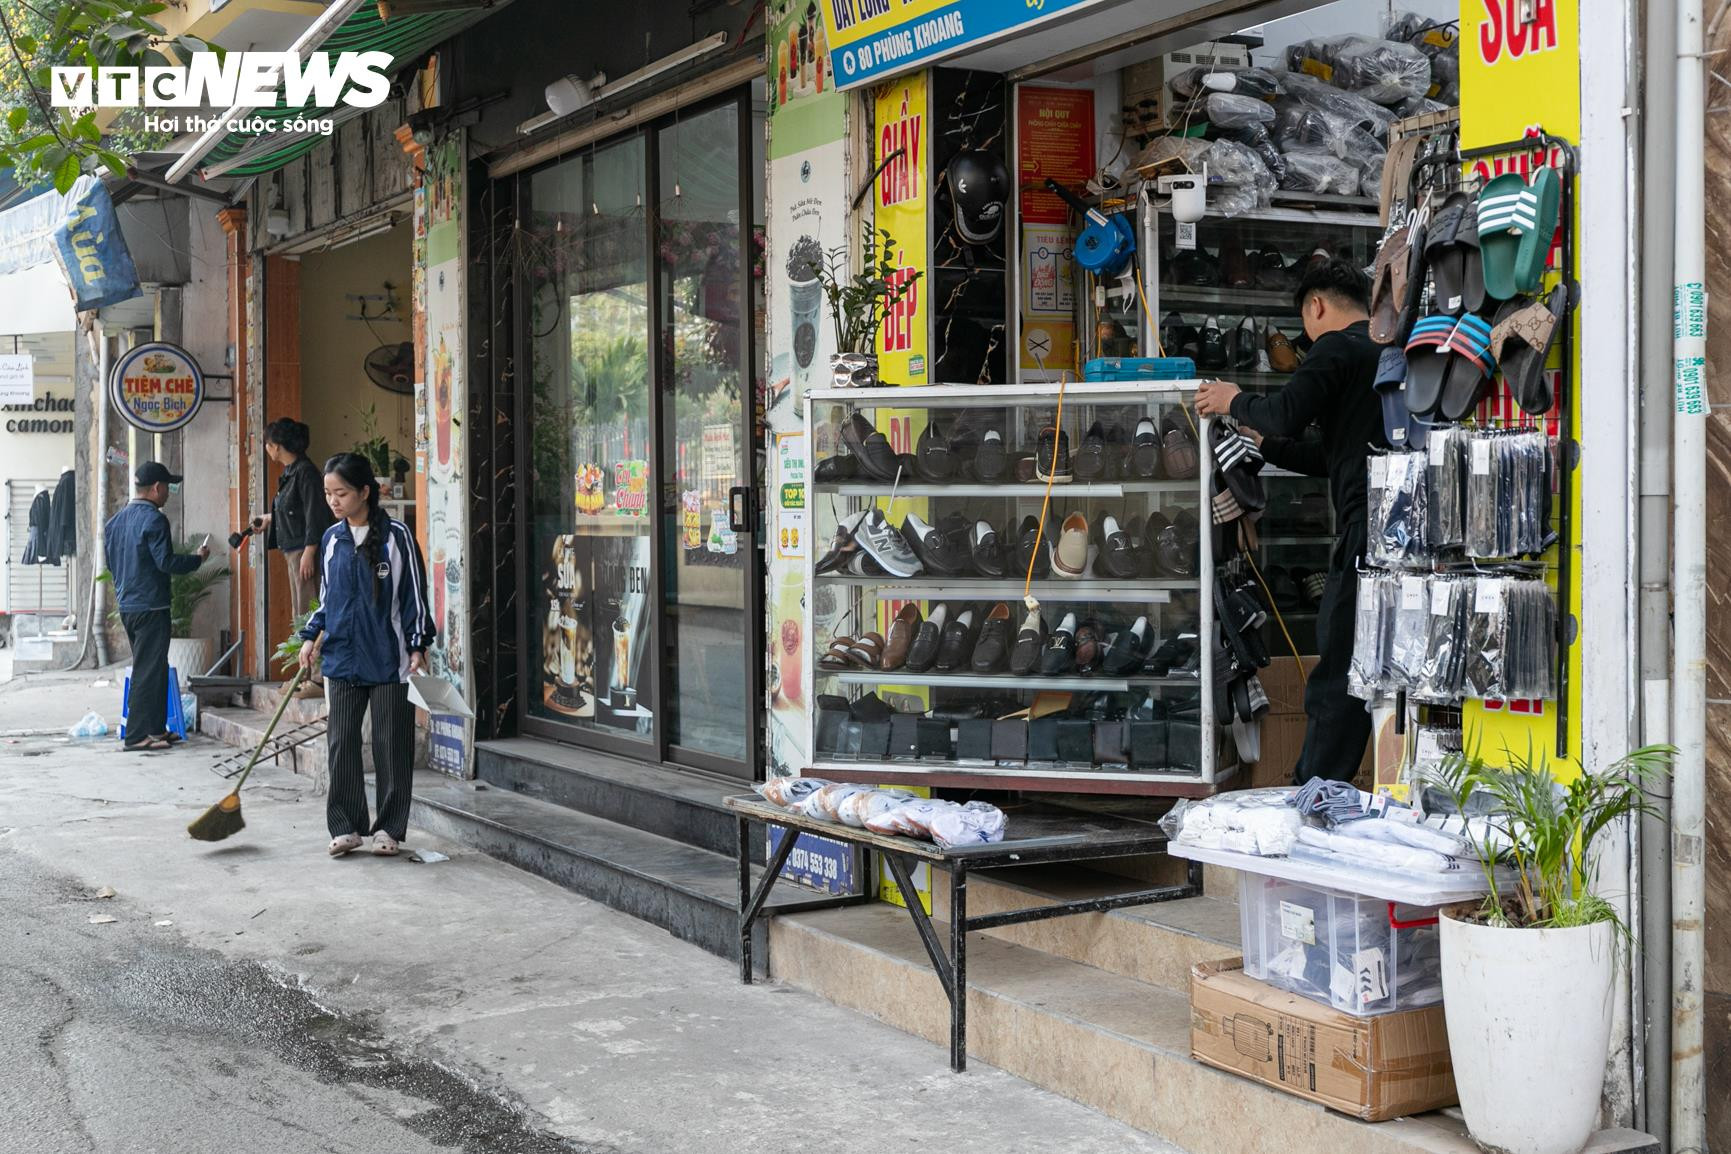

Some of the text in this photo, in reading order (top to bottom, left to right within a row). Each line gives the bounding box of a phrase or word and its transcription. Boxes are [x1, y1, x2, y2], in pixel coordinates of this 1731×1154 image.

[858, 11, 964, 71] 80 PHÙNG KHOANG
[6, 419, 74, 434] camon
[784, 489, 798, 499] TOP
[792, 848, 838, 880] 0374 553 338
